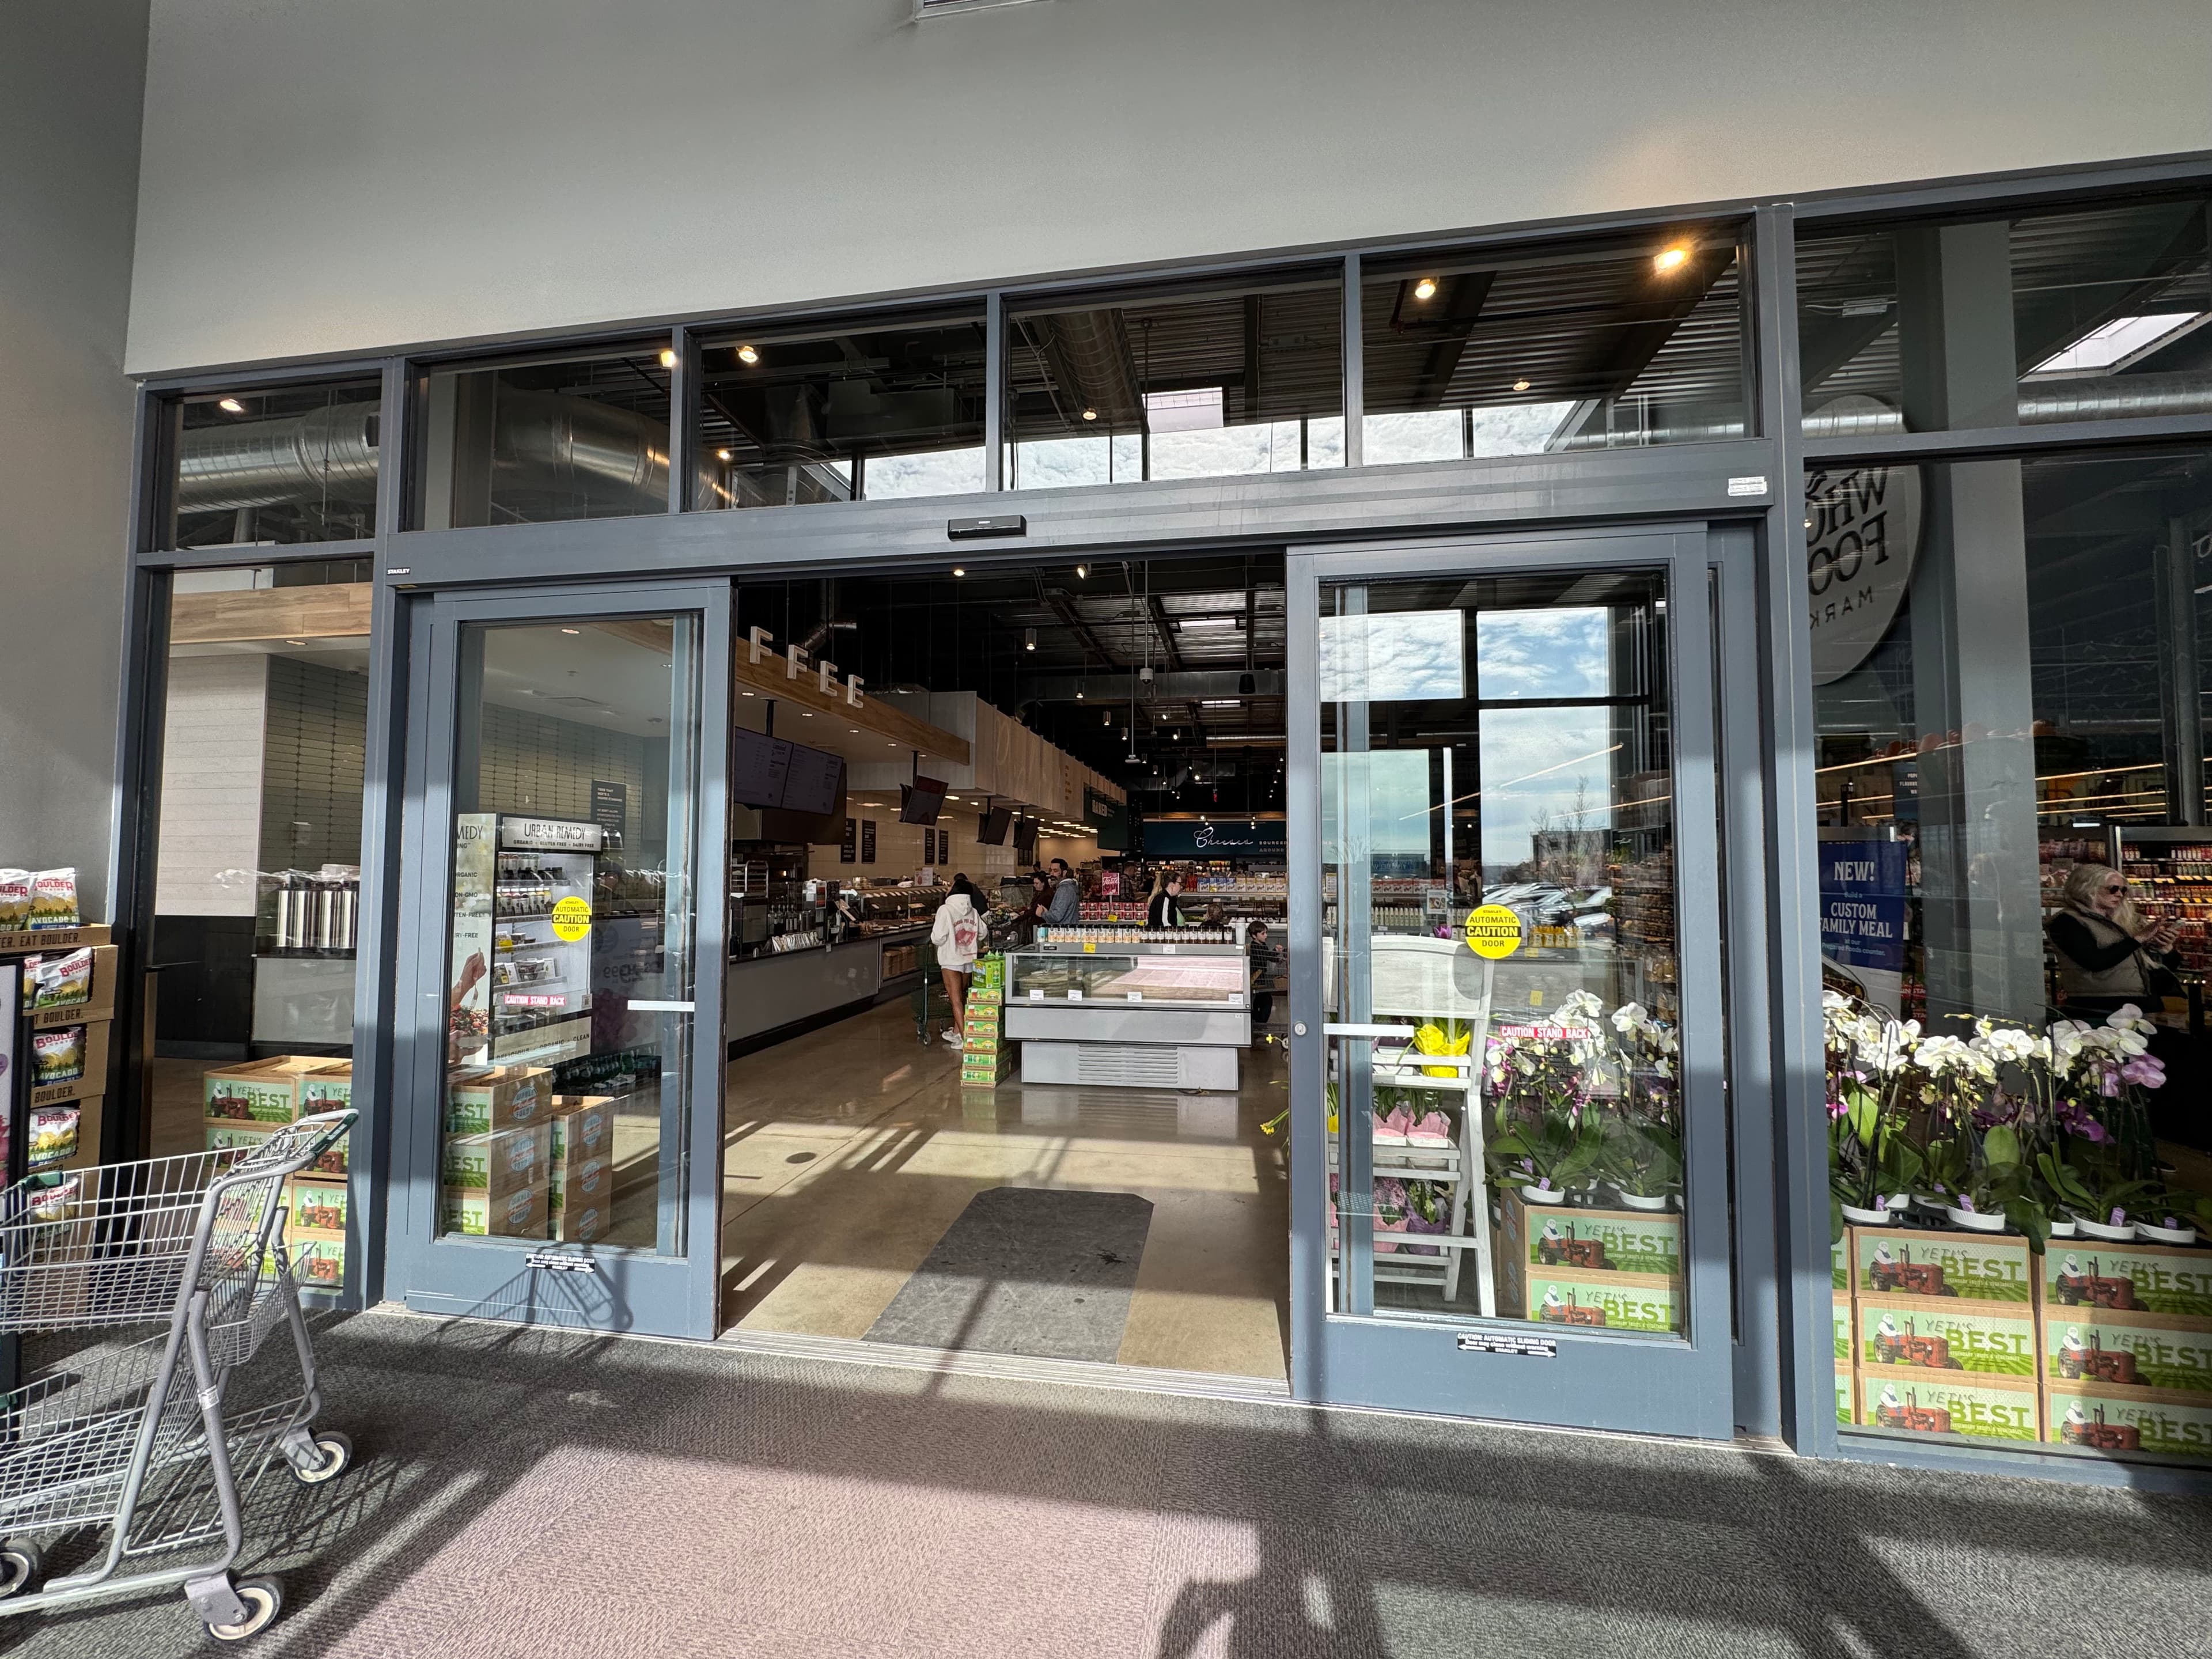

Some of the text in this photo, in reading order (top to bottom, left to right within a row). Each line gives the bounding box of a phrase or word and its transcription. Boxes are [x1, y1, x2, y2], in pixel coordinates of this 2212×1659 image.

[524, 823, 586, 840] URBAN REMEDY
[1834, 861, 1875, 881] NEW!
[1831, 902, 1877, 920] CUSTOM
[553, 915, 589, 923] CAUTION
[1467, 926, 1518, 937] CAUTION
[1858, 921, 1893, 938] MEAL
[20, 935, 39, 947] EAT
[41, 933, 81, 945] BOULDER.
[506, 995, 565, 1005] CAUTION STAND BACK
[44, 1009, 84, 1024] BOULDER.
[573, 1033, 590, 1042] CLEAN
[1501, 1027, 1588, 1039] CAUTION STAND BACK
[247, 1092, 290, 1107] BEST
[1584, 1224, 1626, 1237] YETI'S
[1602, 1232, 1673, 1255] BEST
[1921, 1246, 1969, 1262] YETI'S
[1941, 1256, 2022, 1281] BEST
[2131, 1268, 2212, 1295] BEST
[1586, 1291, 1627, 1304] YETI'S
[1603, 1299, 1675, 1324] BEST
[1925, 1319, 1974, 1334] YETI'S
[1484, 1335, 1517, 1343] AUTOMATIC
[1946, 1328, 2027, 1354] BEST
[1927, 1390, 1975, 1406] YETI'S
[1948, 1400, 2029, 1427] BEST
